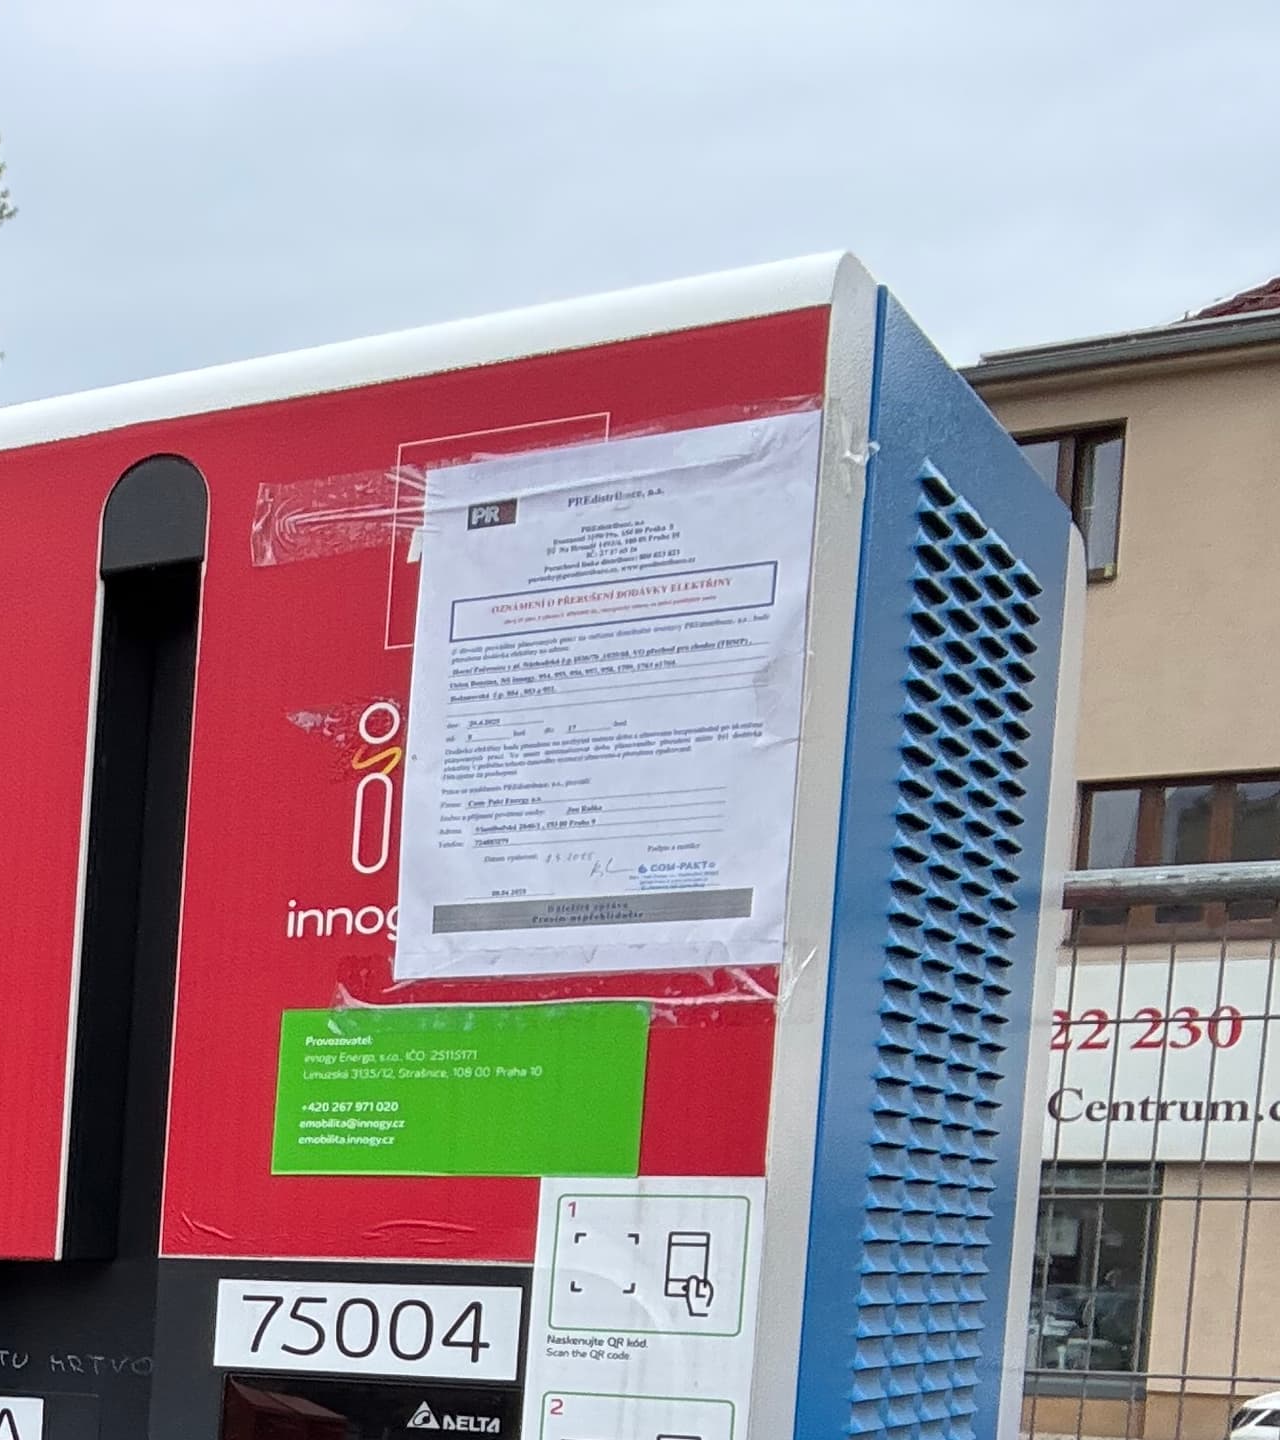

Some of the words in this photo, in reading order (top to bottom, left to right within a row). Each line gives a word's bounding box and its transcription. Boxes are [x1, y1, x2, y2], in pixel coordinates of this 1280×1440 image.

[287, 899, 399, 941] innog
[1130, 1005, 1243, 1049] 230
[304, 1035, 374, 1047] Provozovatel:
[303, 1053, 337, 1064] innogy
[473, 1066, 490, 1078] 00
[495, 1066, 527, 1079] Praha
[530, 1065, 543, 1077] 10
[300, 1102, 330, 1112] +420
[331, 1102, 353, 1112] 267
[354, 1101, 374, 1112] 971
[375, 1101, 398, 1112] 020
[299, 1117, 404, 1129] emobilita@innogy.cz
[298, 1134, 395, 1146] emobilita.innogy.cz
[567, 1201, 577, 1218] 1
[243, 1294, 490, 1364] 75004
[546, 1334, 604, 1347] Naskenujte
[607, 1336, 624, 1348] QR
[626, 1337, 649, 1348] kód.
[545, 1347, 569, 1357] Scan
[571, 1348, 587, 1358] the
[589, 1349, 604, 1360] QR
[549, 1398, 564, 1415] 2
[442, 1414, 501, 1433] DELTA
